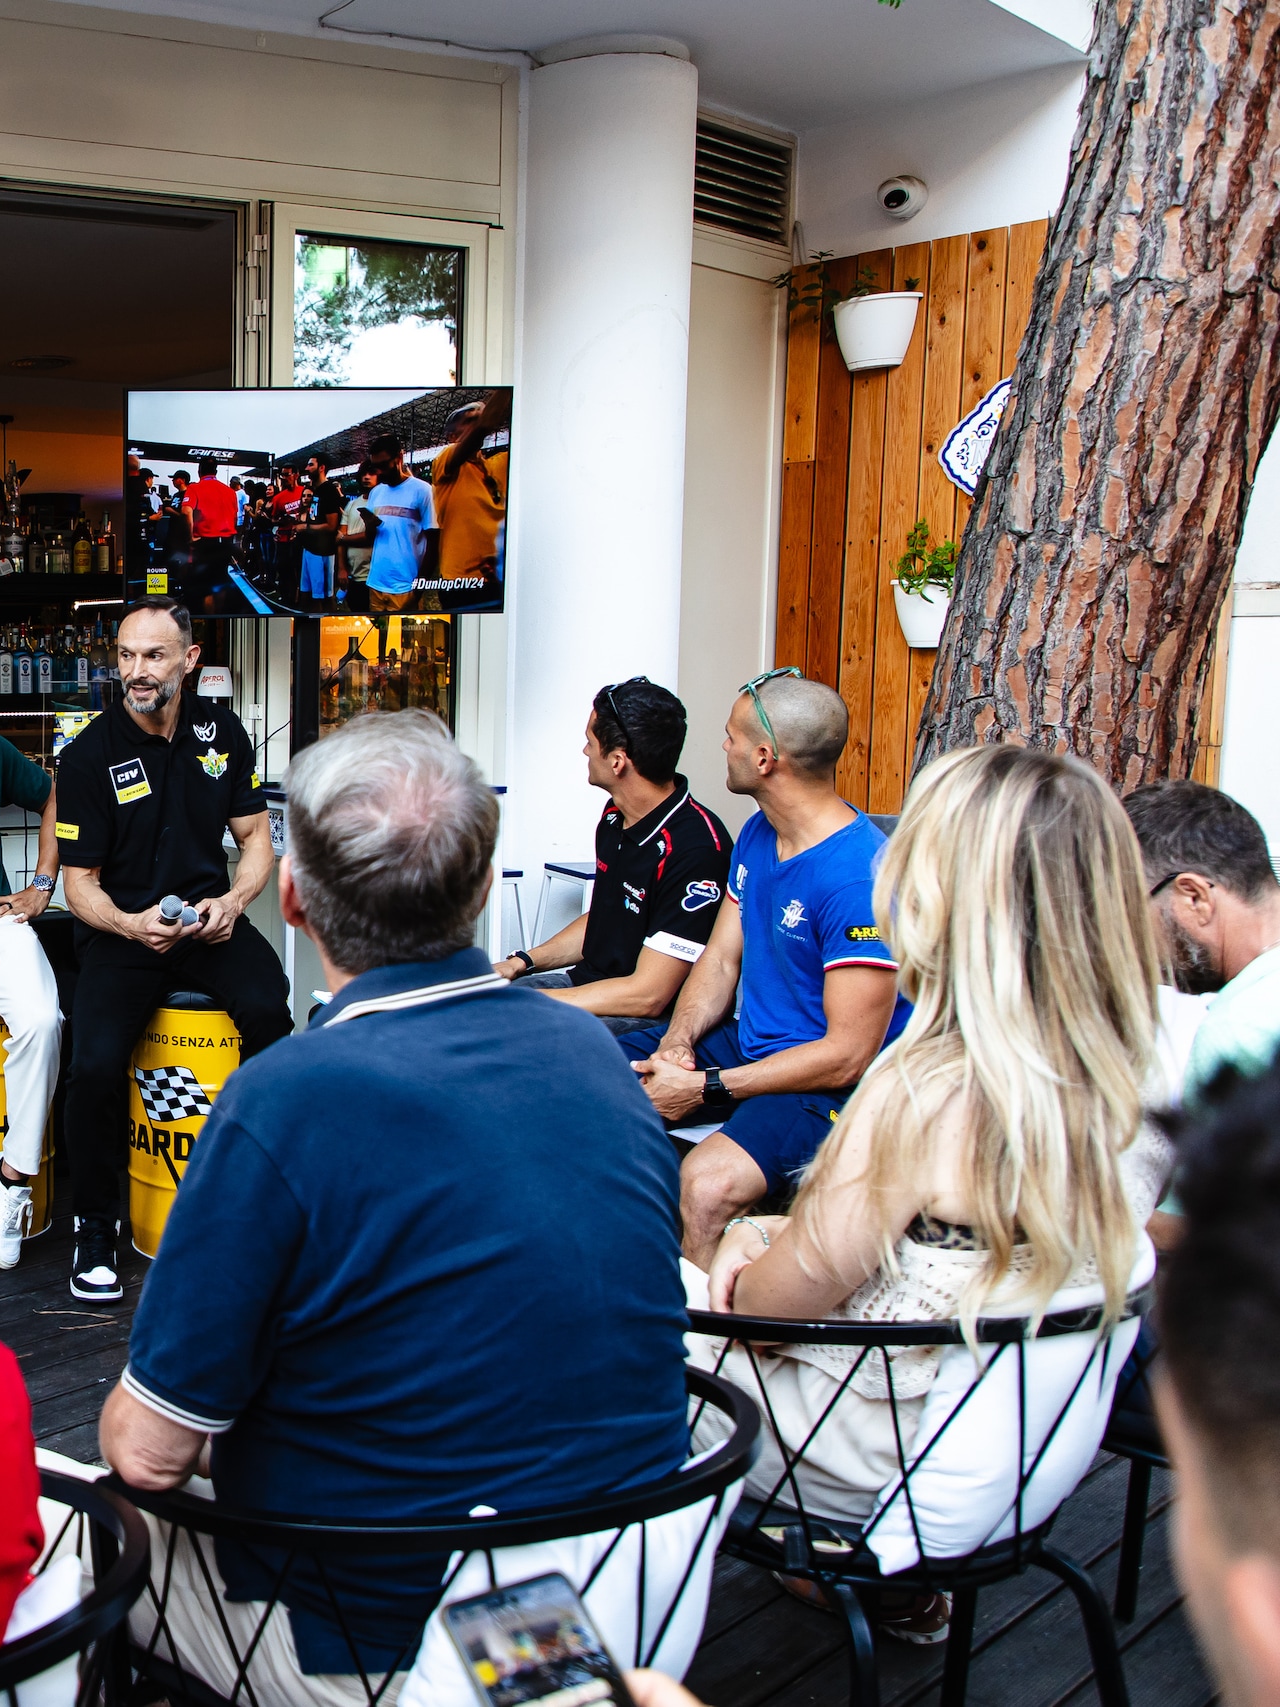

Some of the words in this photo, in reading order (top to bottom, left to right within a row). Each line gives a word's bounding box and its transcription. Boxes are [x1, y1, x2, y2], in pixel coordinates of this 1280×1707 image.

[411, 577, 484, 591] #DunlopCIV24
[117, 768, 139, 783] CIV
[850, 927, 881, 938] ARR
[172, 1035, 215, 1048] SENZA
[129, 1120, 197, 1162] BARD
